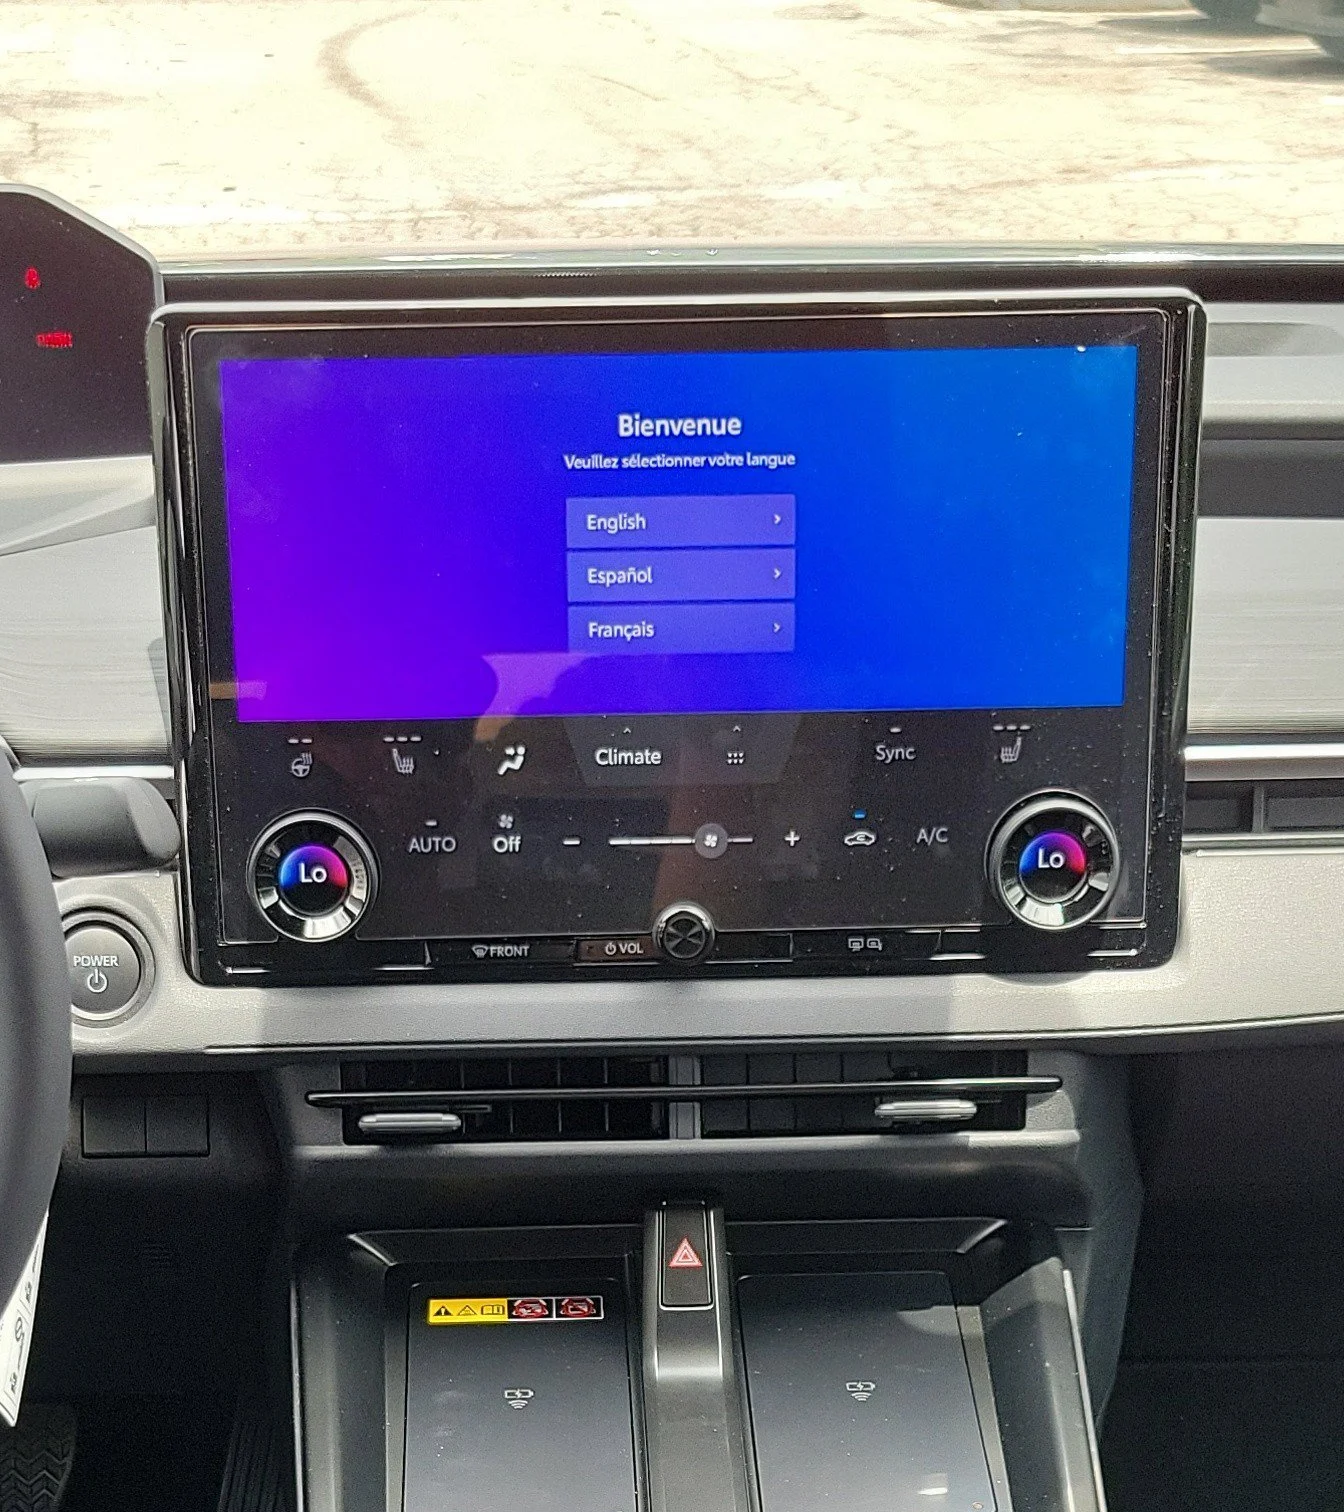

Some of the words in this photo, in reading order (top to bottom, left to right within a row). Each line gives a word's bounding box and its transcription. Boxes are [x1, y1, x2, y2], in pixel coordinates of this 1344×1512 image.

[617, 412, 742, 437] Bienvenue
[563, 453, 619, 469] Veuillez
[621, 452, 707, 469] sélectionner
[708, 452, 744, 467] votre
[746, 451, 796, 469] langue
[586, 512, 647, 534] English
[587, 566, 653, 588] Español
[588, 621, 655, 641] Français
[595, 748, 662, 766] Climate
[875, 744, 917, 763] Sync
[408, 837, 457, 853] AUTO
[492, 836, 522, 853] Off
[916, 827, 949, 846] A/C
[1037, 848, 1066, 869] Lo
[298, 862, 328, 883] Lo
[489, 944, 530, 958] FRONT
[618, 941, 644, 955] VOL
[73, 955, 119, 967] POWER
